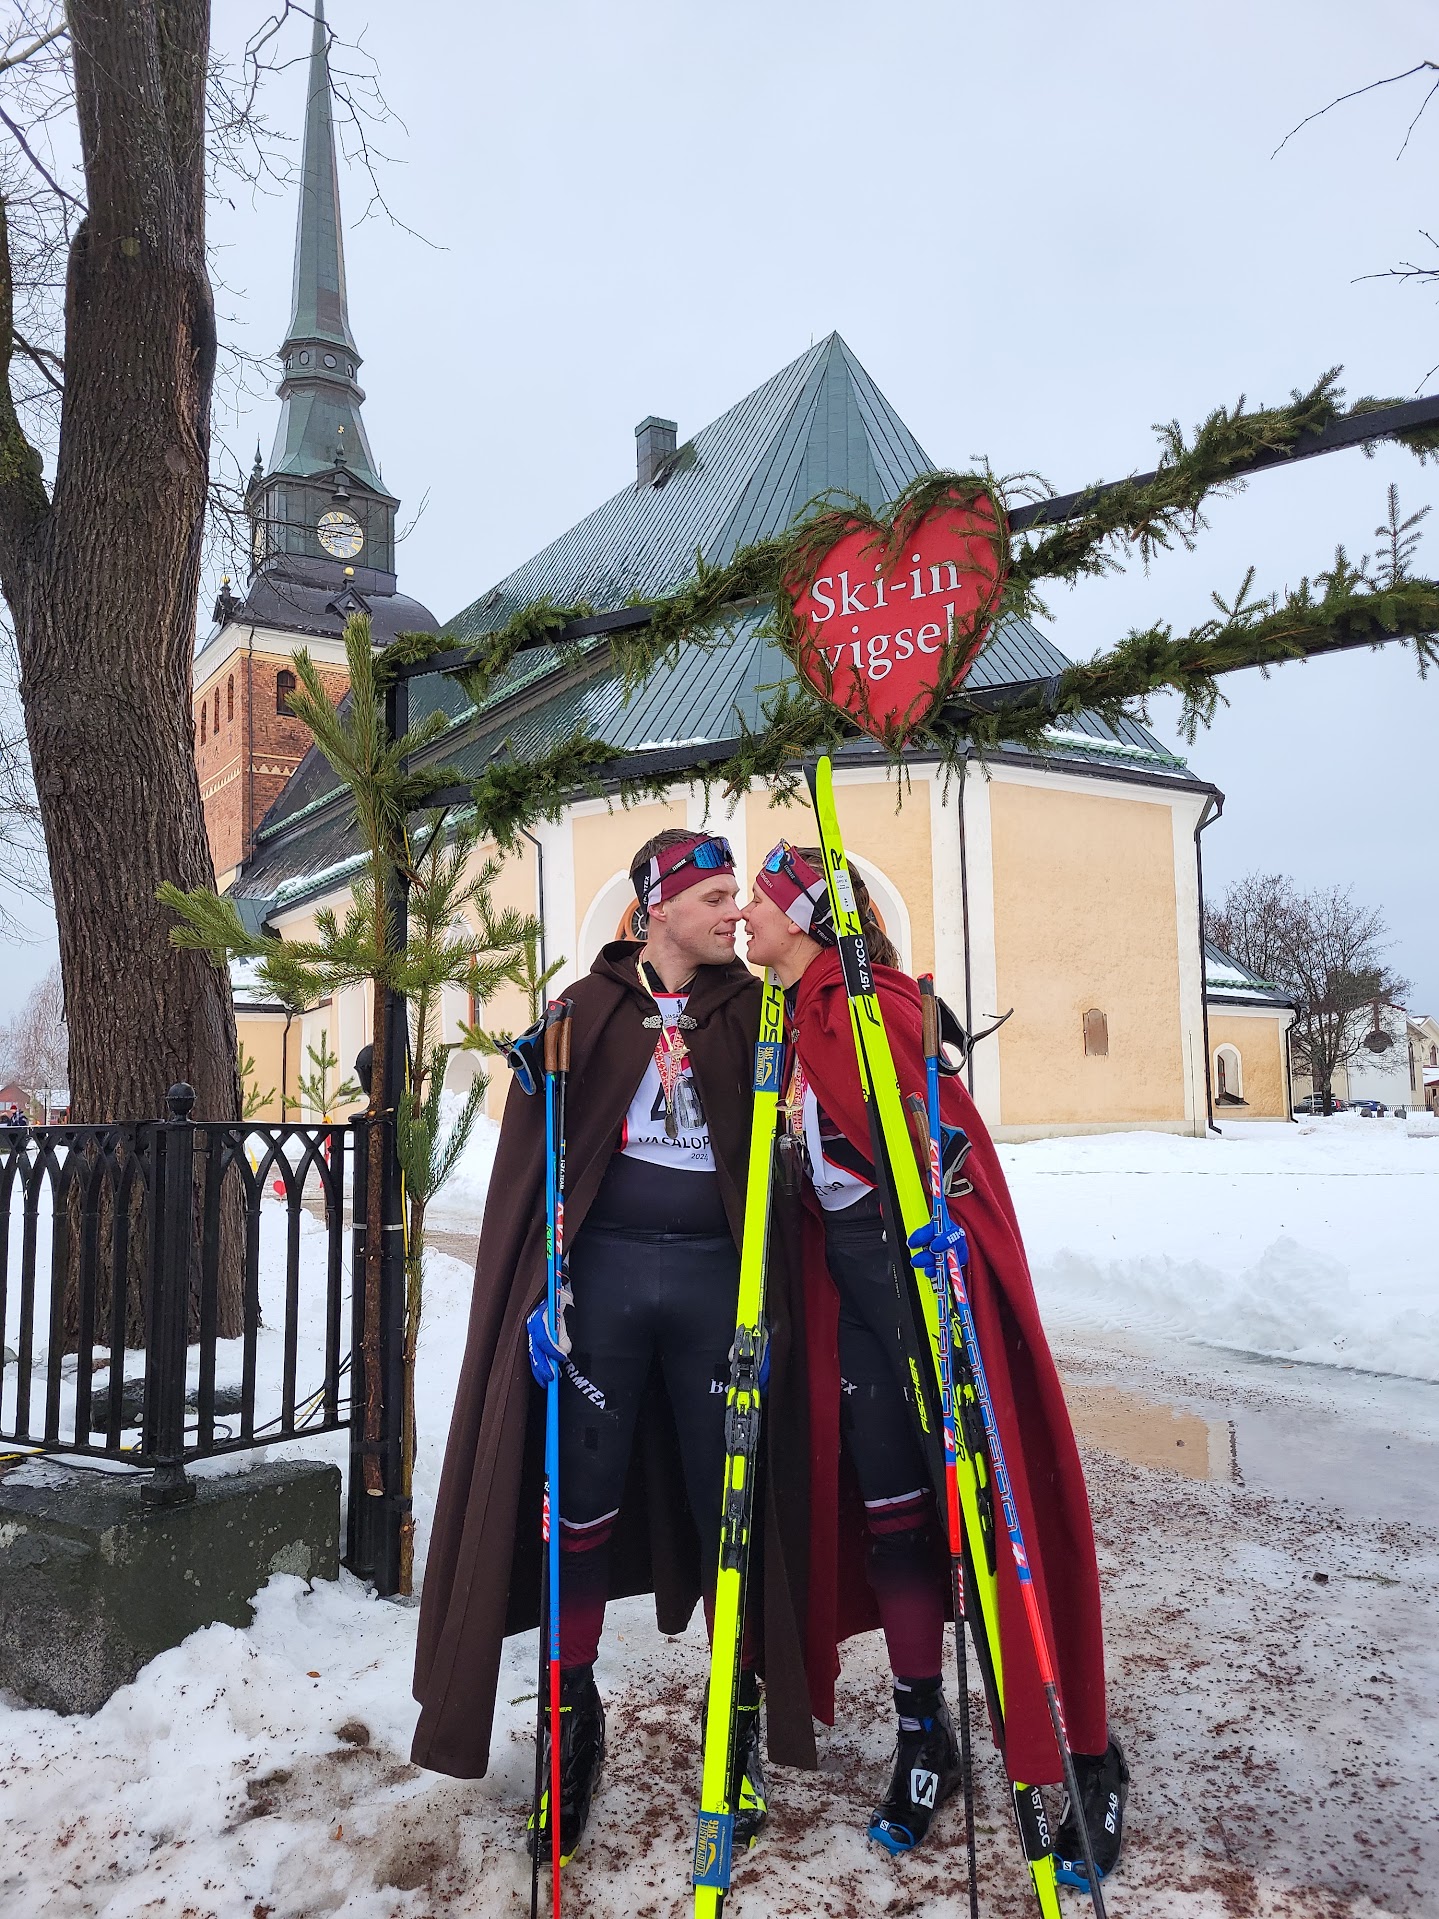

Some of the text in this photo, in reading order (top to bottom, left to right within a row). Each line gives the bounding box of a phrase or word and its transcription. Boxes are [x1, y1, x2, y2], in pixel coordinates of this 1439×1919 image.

[811, 553, 962, 623] Ski-in
[818, 602, 957, 681] vigsel
[854, 938, 868, 967] XCC
[858, 969, 871, 991] 157
[909, 1357, 931, 1434] FISCHER
[708, 1819, 719, 1839] SVEG
[1030, 1786, 1051, 1848] 157 XCC
[695, 1818, 709, 1877] SKIDGYMNASIET
